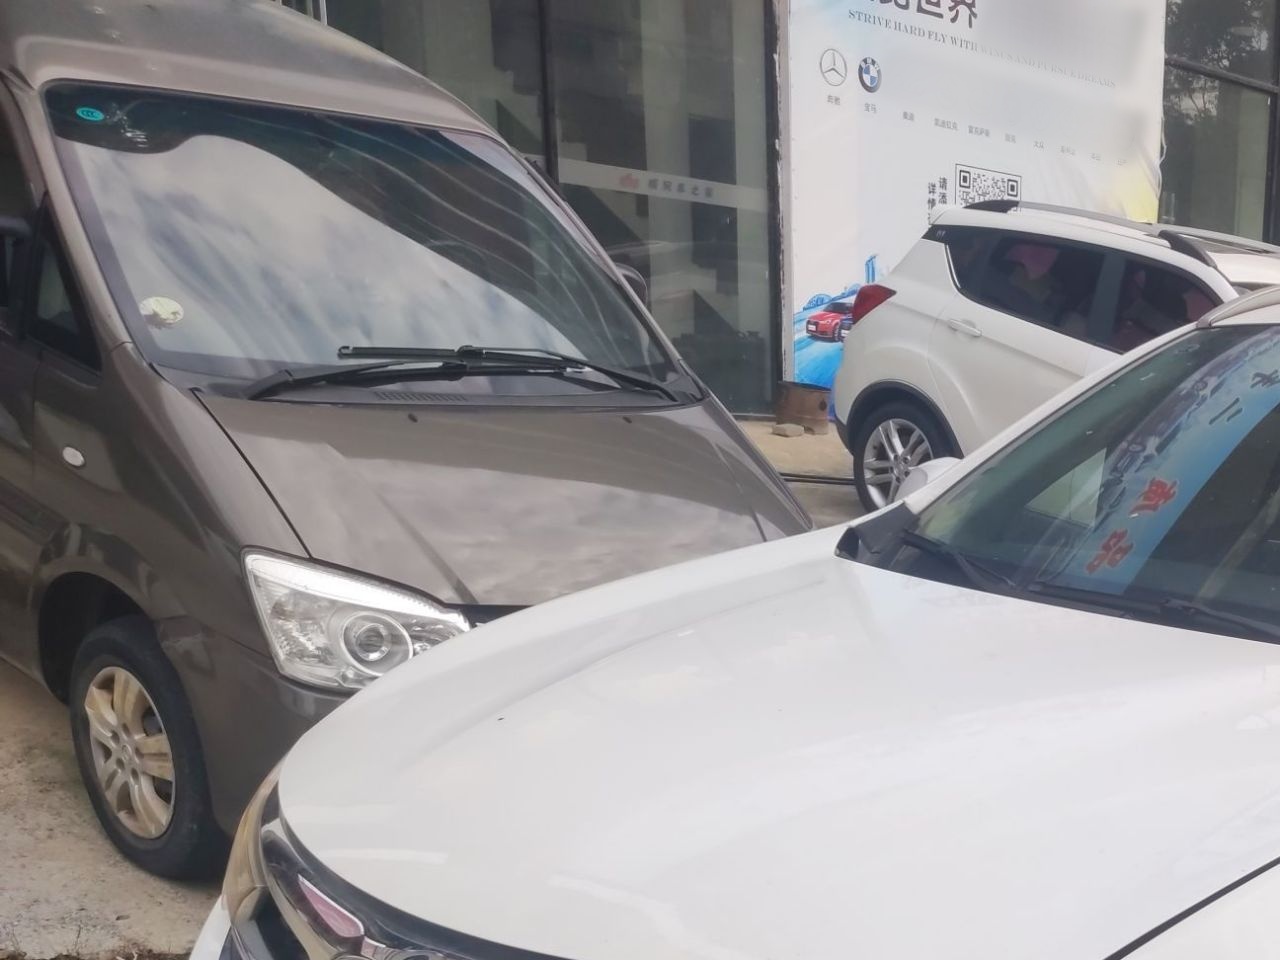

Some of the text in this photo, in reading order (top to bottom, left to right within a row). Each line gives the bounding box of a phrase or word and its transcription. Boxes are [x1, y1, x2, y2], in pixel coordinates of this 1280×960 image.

[848, 9, 892, 29] STRIVE
[894, 22, 925, 38] HARD
[928, 28, 948, 44] FLY
[951, 36, 978, 52] WITH
